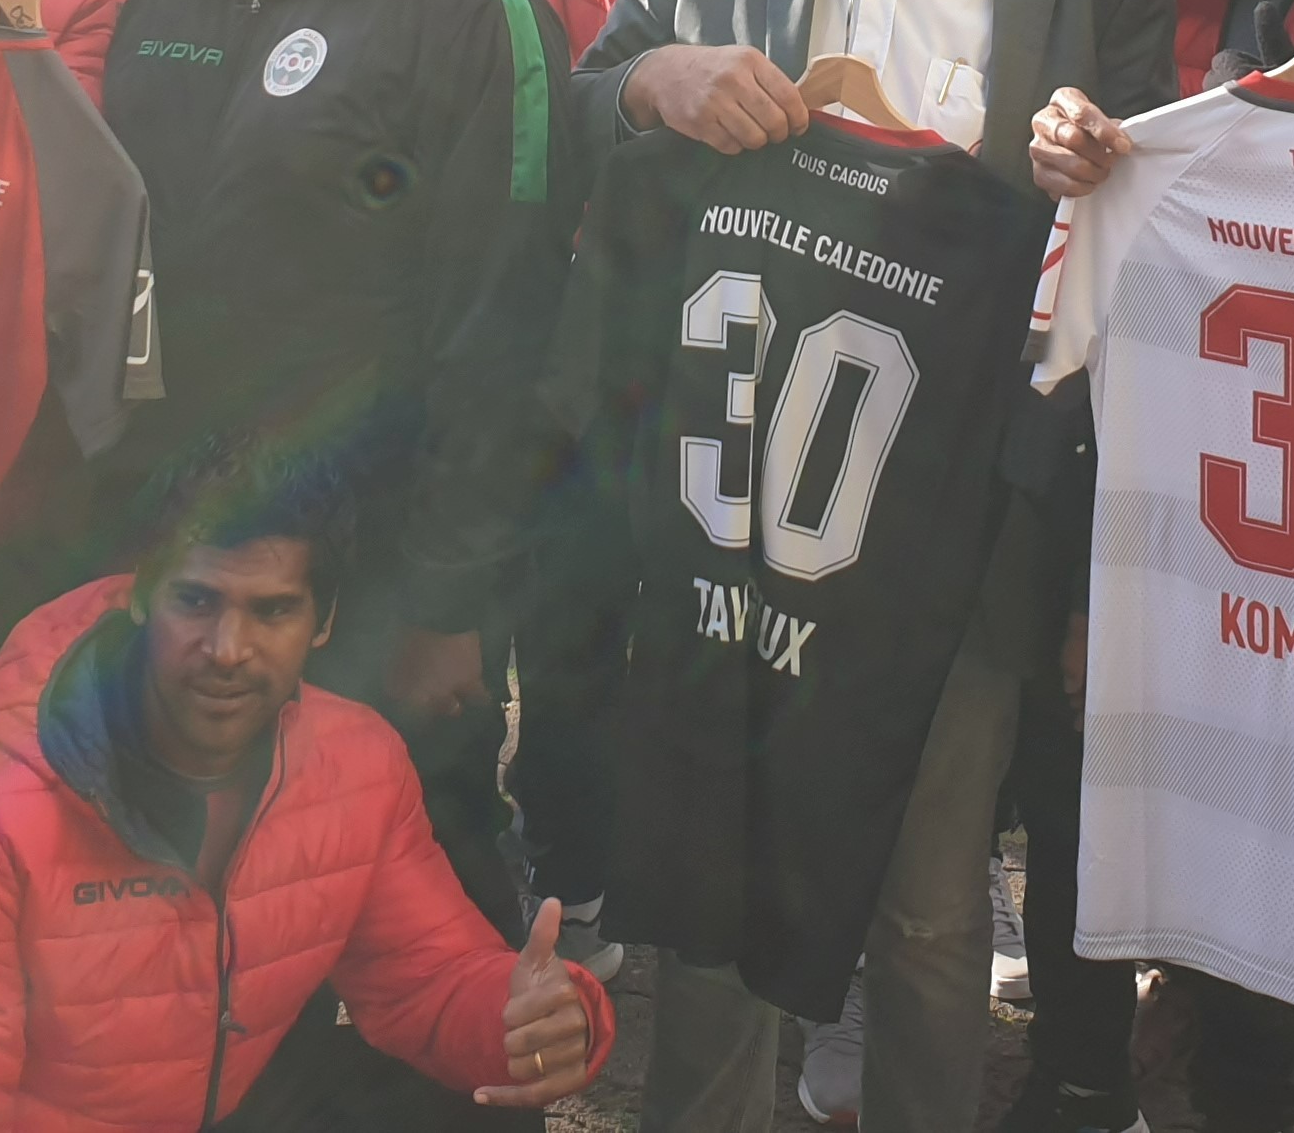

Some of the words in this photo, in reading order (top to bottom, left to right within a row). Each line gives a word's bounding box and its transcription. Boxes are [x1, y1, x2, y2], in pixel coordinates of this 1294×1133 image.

[138, 40, 223, 67] GIVOVA
[791, 148, 828, 177] TOUS
[829, 164, 889, 195] CAGOUS
[700, 205, 811, 255] NOUVELLE
[813, 234, 944, 306] CALEDONIE
[680, 269, 921, 581] 30
[693, 577, 817, 677] TAVUX
